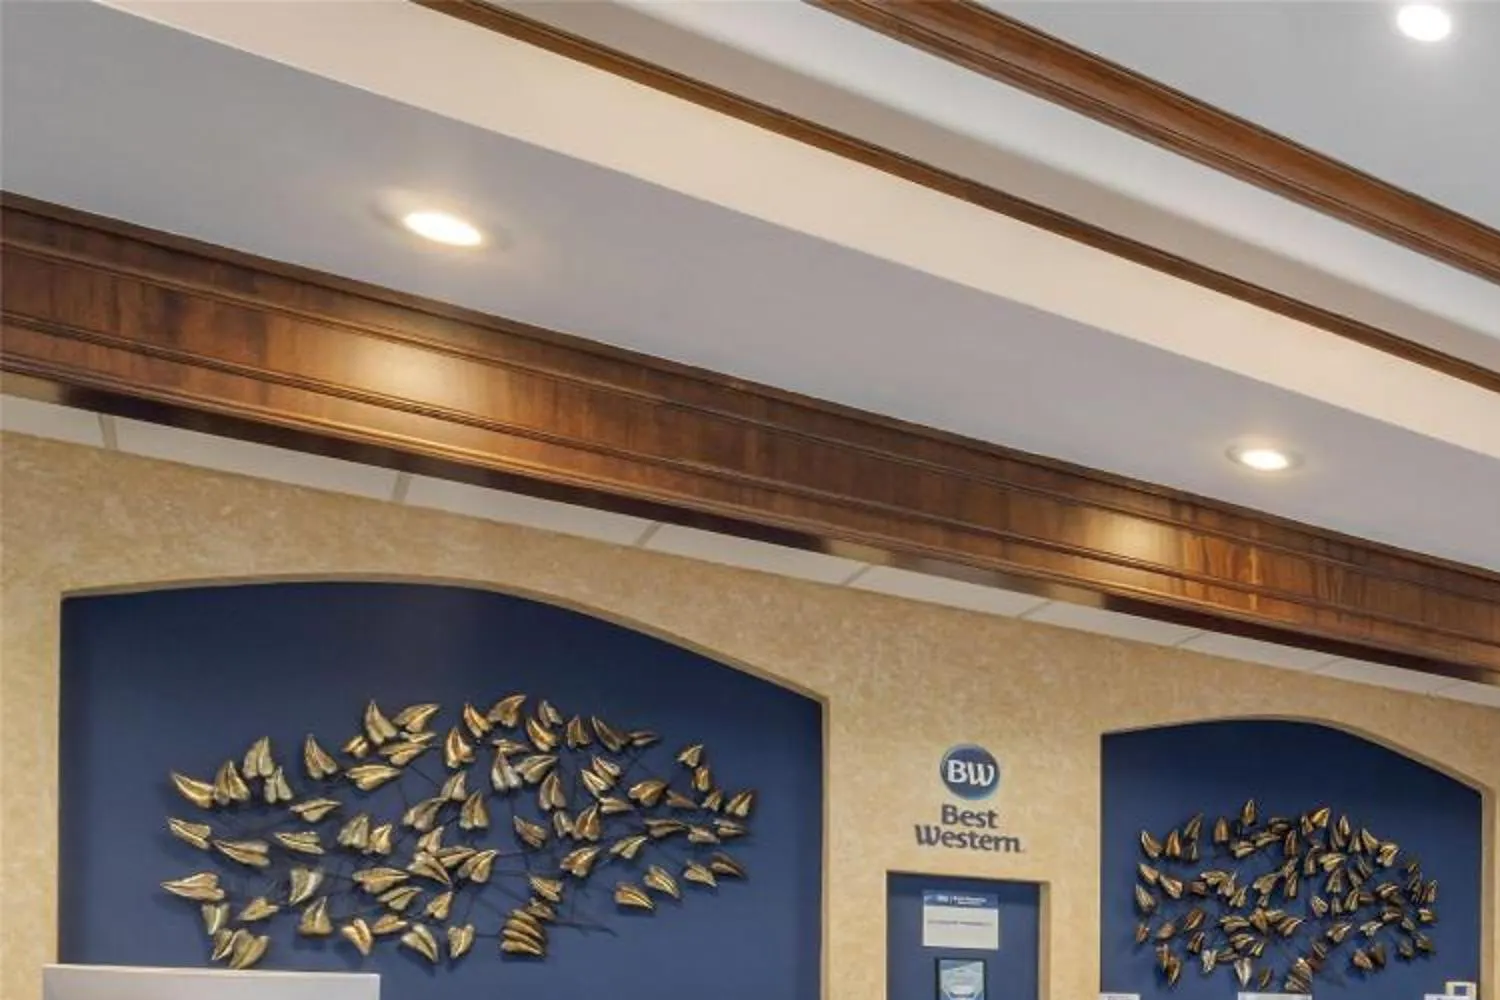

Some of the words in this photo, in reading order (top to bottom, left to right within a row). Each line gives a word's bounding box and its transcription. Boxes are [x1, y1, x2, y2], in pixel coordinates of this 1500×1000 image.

[947, 759, 995, 787] BW
[942, 803, 999, 829] Best
[914, 824, 1021, 853] Western
